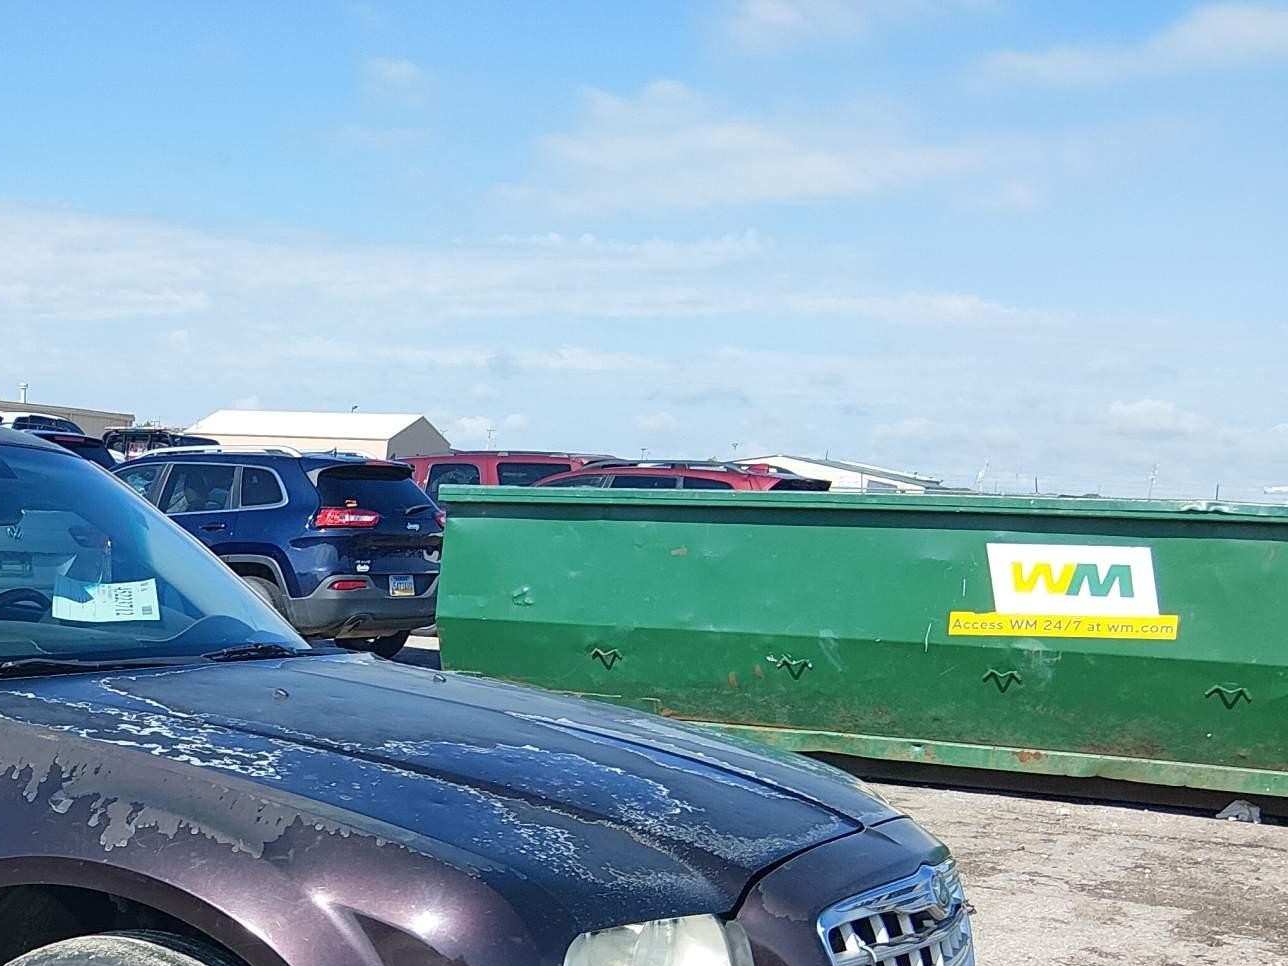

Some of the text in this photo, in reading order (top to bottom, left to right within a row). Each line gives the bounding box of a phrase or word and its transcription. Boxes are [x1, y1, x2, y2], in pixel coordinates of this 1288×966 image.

[1011, 562, 1134, 597] WM
[952, 619, 1174, 634] Access WM 24/7 at wm.com
